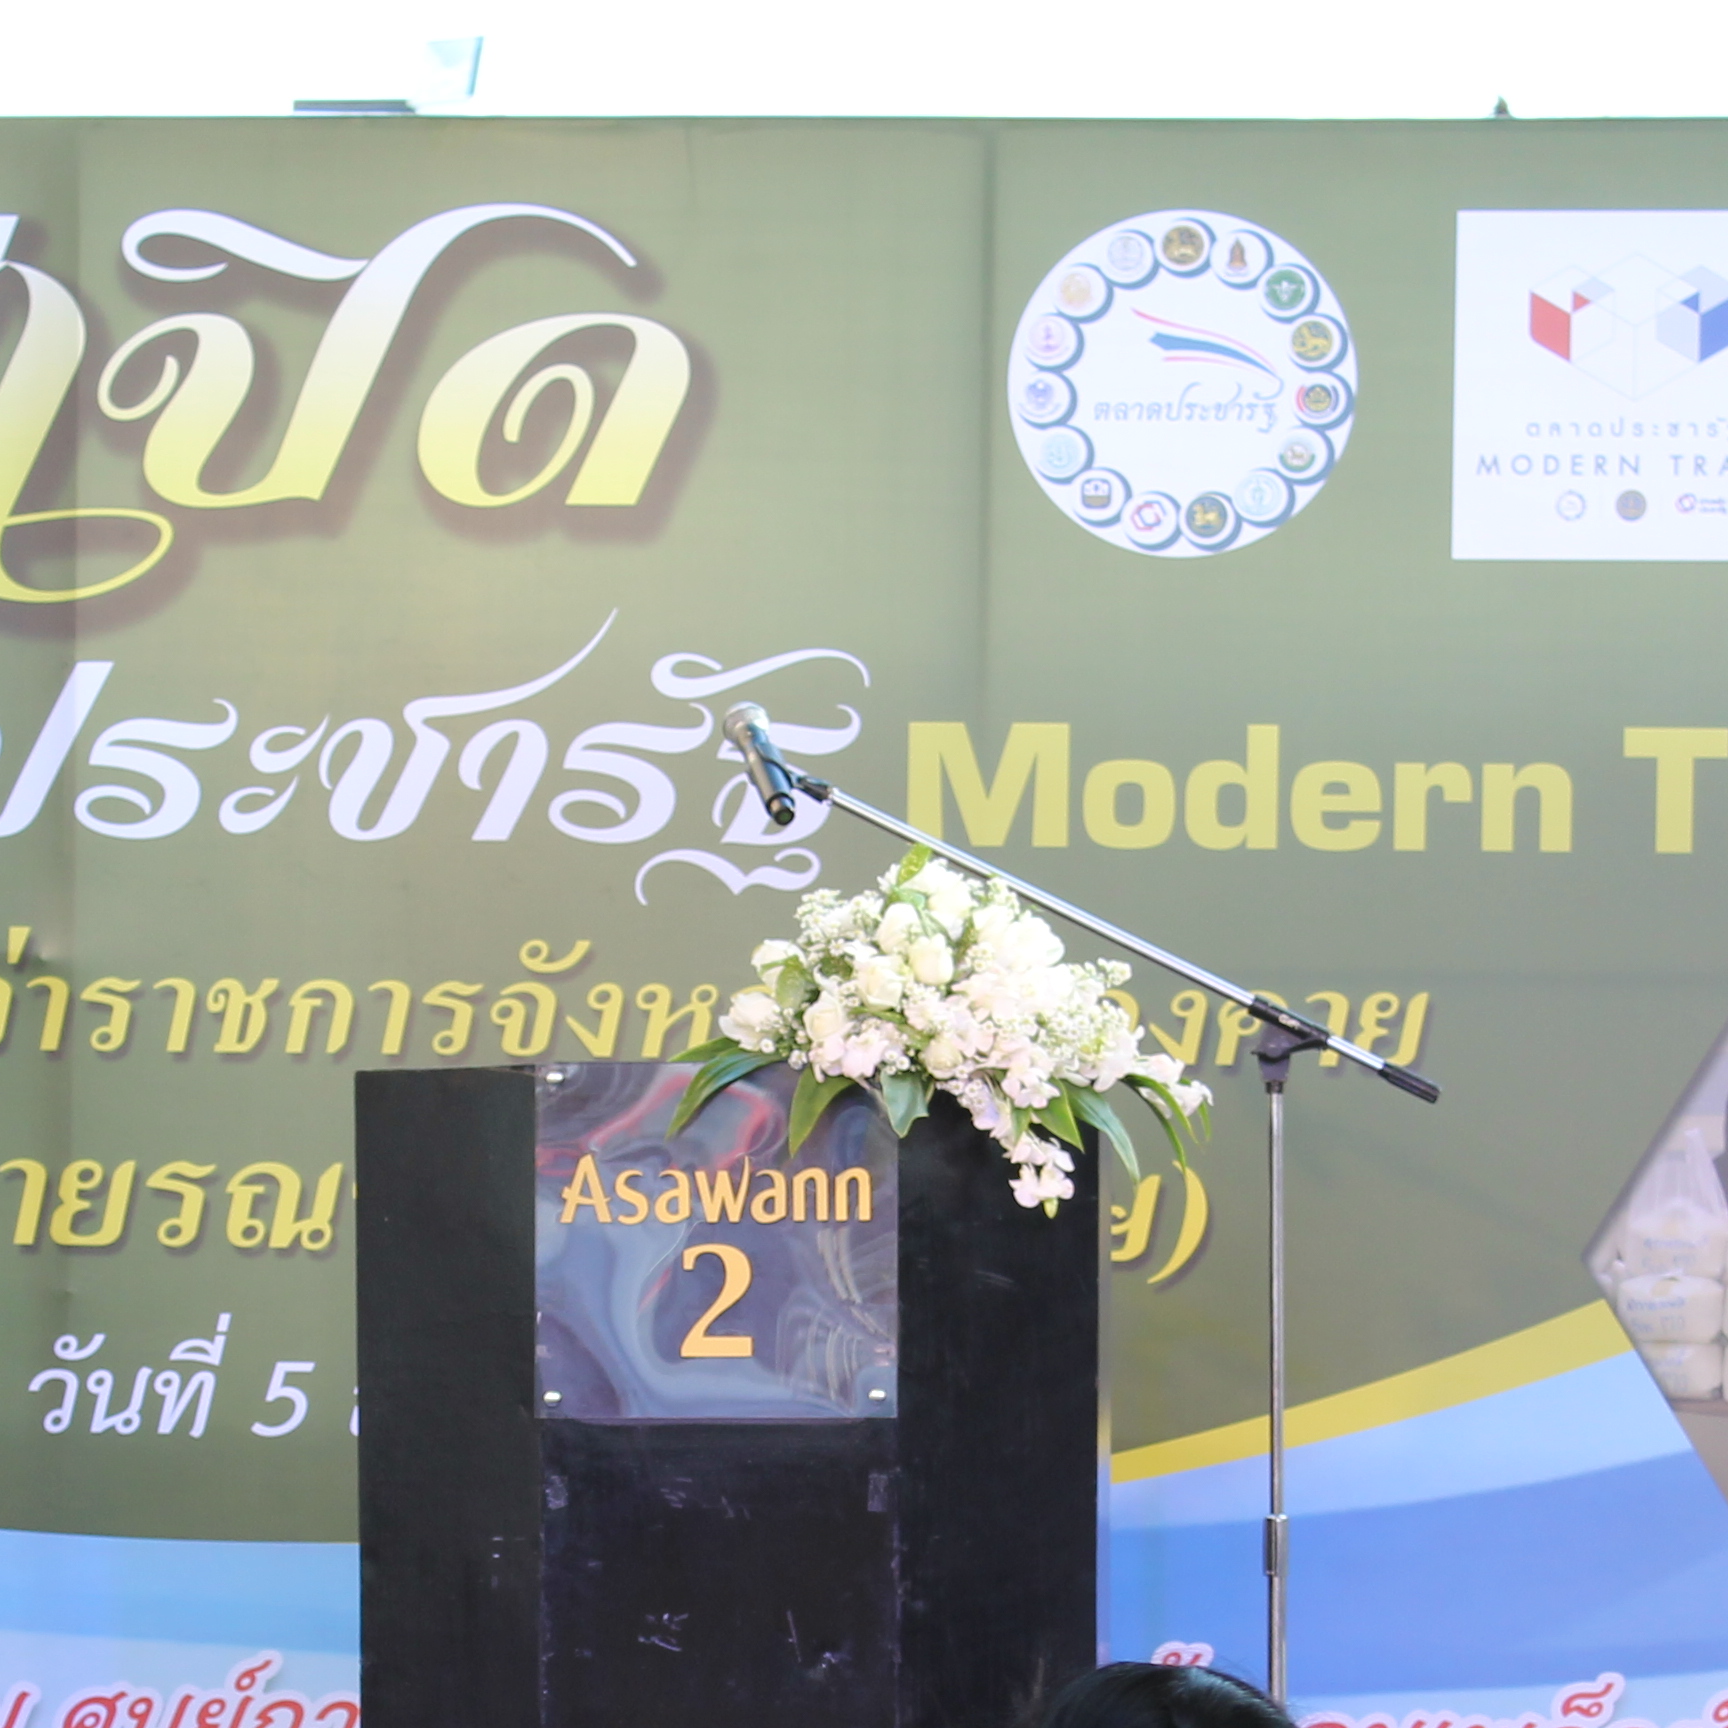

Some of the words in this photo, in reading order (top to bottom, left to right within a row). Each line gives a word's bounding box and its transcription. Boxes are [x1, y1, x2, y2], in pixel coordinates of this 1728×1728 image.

[1476, 455, 1641, 476] MODERN
[907, 721, 1573, 853] Modern
[560, 1154, 873, 1226] Asawann
[679, 1244, 754, 1358] 2
[28, 1312, 232, 1439] วันที่
[252, 1359, 314, 1437] 5
